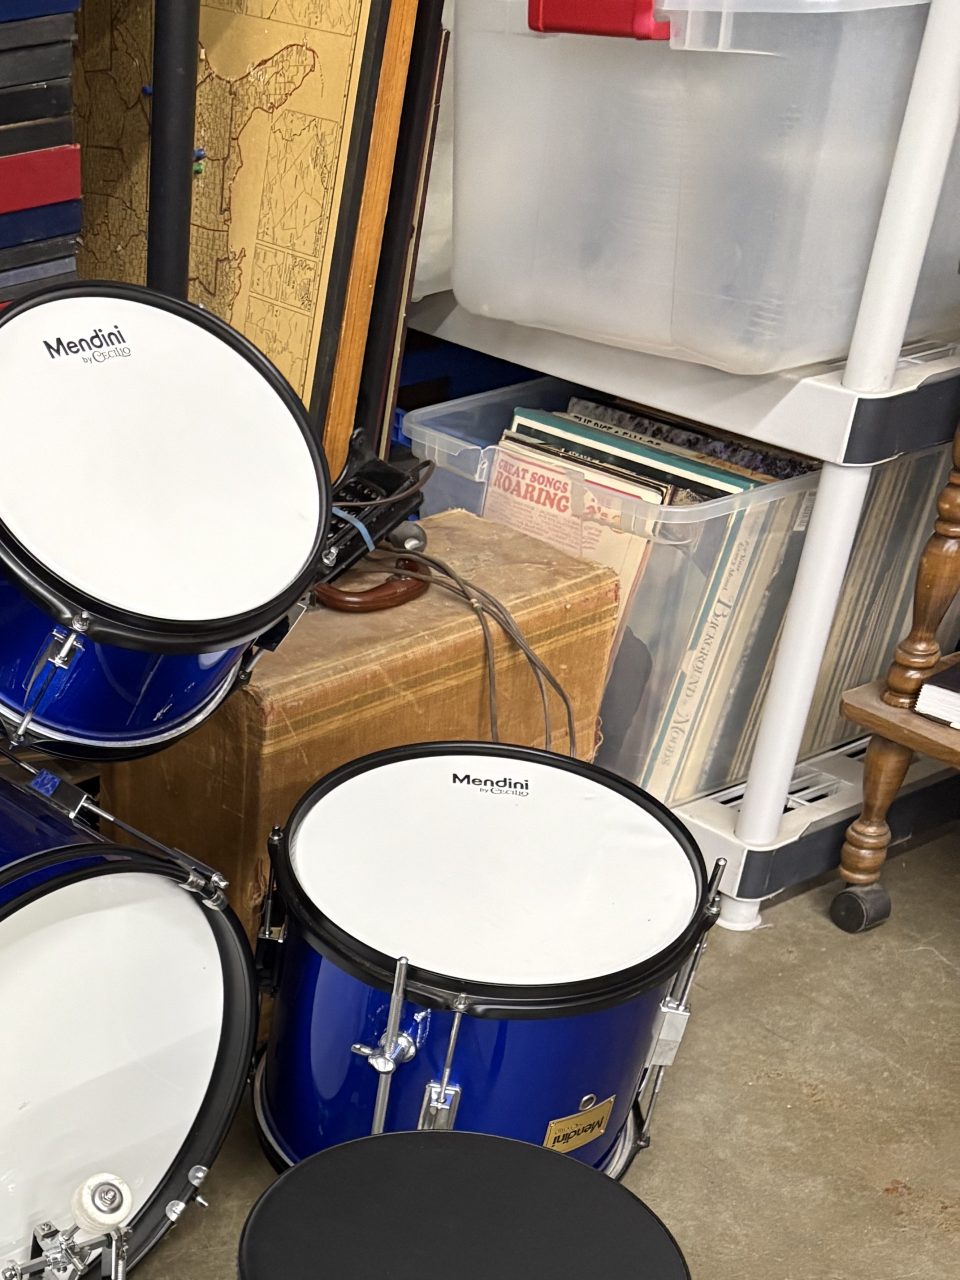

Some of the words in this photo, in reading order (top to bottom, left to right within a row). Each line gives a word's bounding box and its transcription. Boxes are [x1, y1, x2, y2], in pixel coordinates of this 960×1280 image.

[42, 324, 127, 359] Mendini
[81, 356, 93, 364] by
[493, 470, 571, 513] ROARING
[497, 458, 531, 481] GREAT
[530, 469, 570, 494] SONGS
[452, 773, 529, 791] Mendini
[551, 1115, 605, 1148] Mendini
